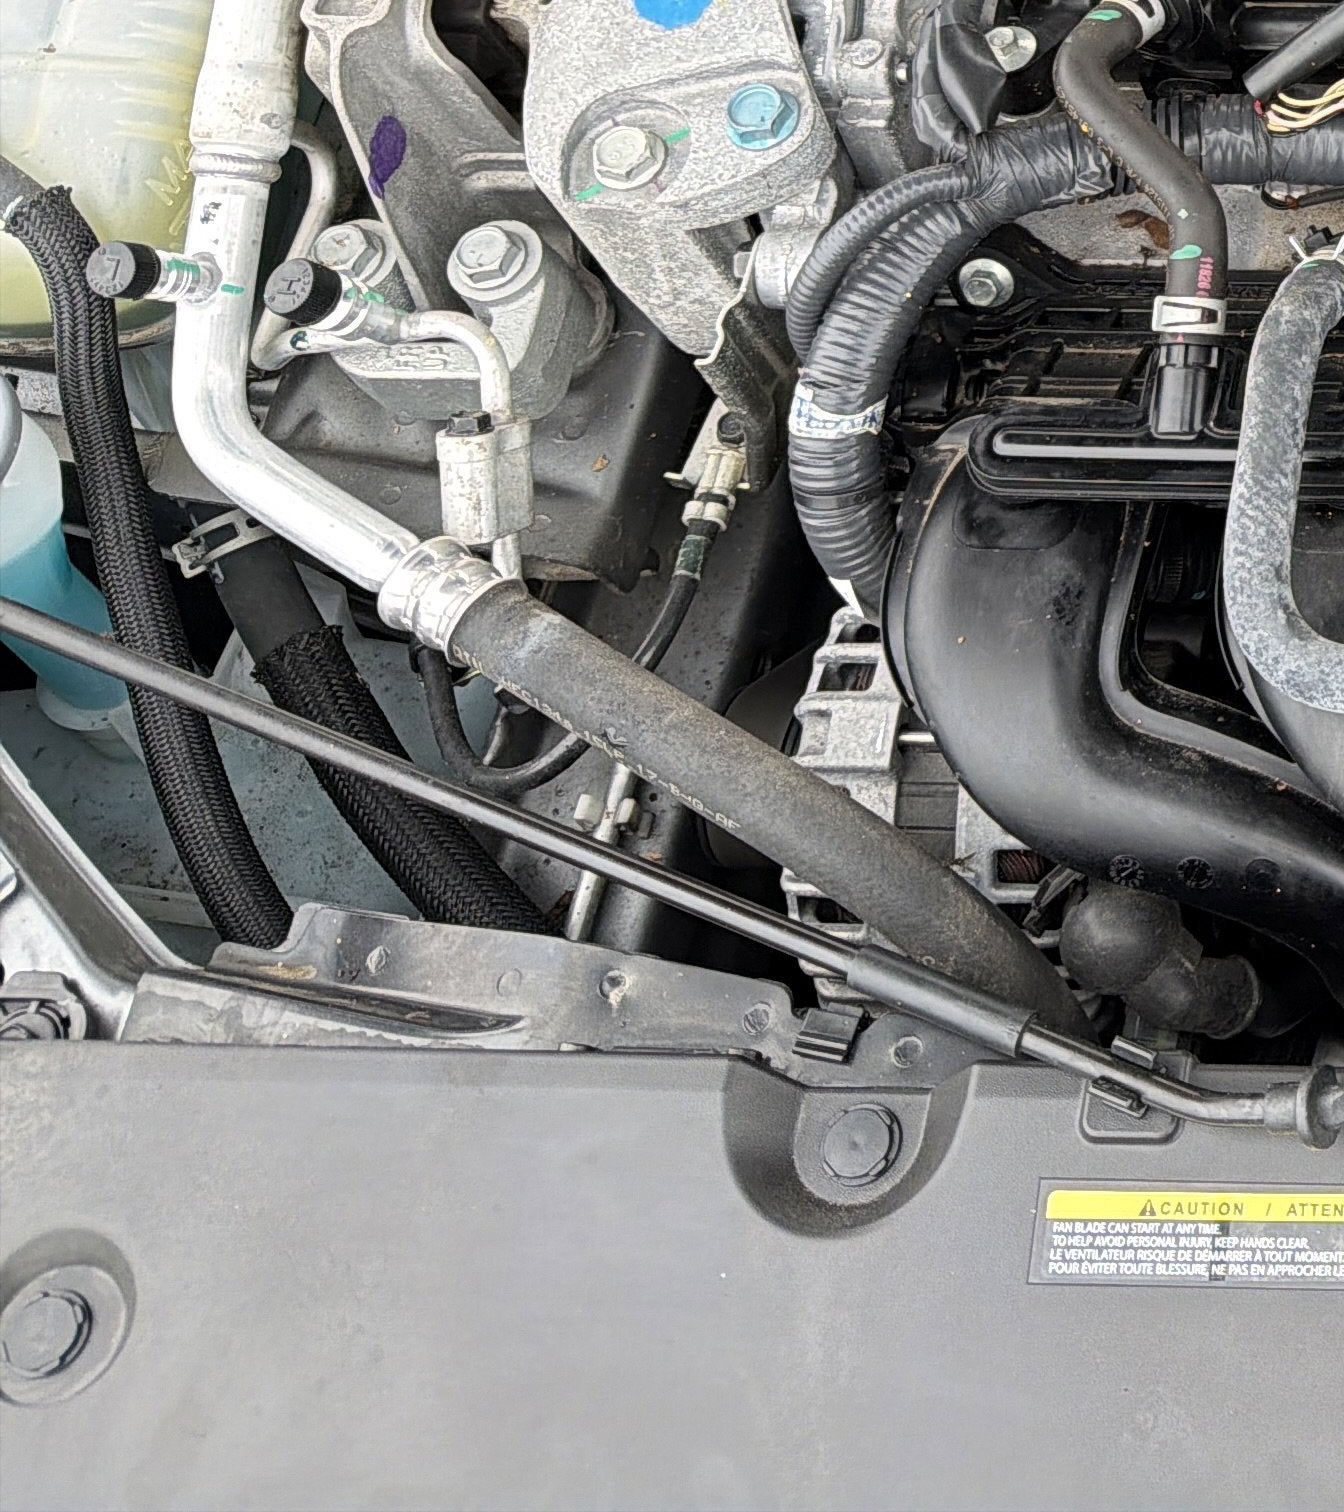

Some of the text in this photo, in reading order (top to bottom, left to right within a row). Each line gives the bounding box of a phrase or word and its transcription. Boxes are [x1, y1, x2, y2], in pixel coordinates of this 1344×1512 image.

[1160, 1201, 1244, 1216] CAUTION
[1266, 1202, 1272, 1217] /
[1052, 1222, 1073, 1233] FAN
[1074, 1222, 1106, 1234] BLADE
[1107, 1223, 1130, 1234] CAN
[1131, 1223, 1160, 1234] START
[1161, 1224, 1175, 1234] AT
[1175, 1224, 1197, 1234] ANY
[1052, 1235, 1067, 1247] TO
[1068, 1235, 1094, 1247] HELP
[1094, 1236, 1125, 1247] AVOID
[1127, 1236, 1178, 1247] PERSONAL
[1215, 1237, 1238, 1248] KEEP
[1240, 1237, 1275, 1249] HANDS
[1050, 1249, 1064, 1260] LE
[1065, 1249, 1135, 1261] VENTILATEUR
[1137, 1250, 1176, 1262] RISQUE
[1177, 1250, 1193, 1261] DE
[1194, 1249, 1252, 1262] DÉMARRER
[1254, 1248, 1262, 1261] À
[1264, 1251, 1294, 1263] TOUT
[1048, 1262, 1079, 1274] POUR
[1080, 1260, 1118, 1274] ÉVITER
[1119, 1263, 1153, 1275] TOUTE
[1211, 1264, 1228, 1275] NE
[1229, 1264, 1249, 1276] PAS
[1250, 1264, 1265, 1276] EN
[1267, 1264, 1332, 1277] APPROCHER
